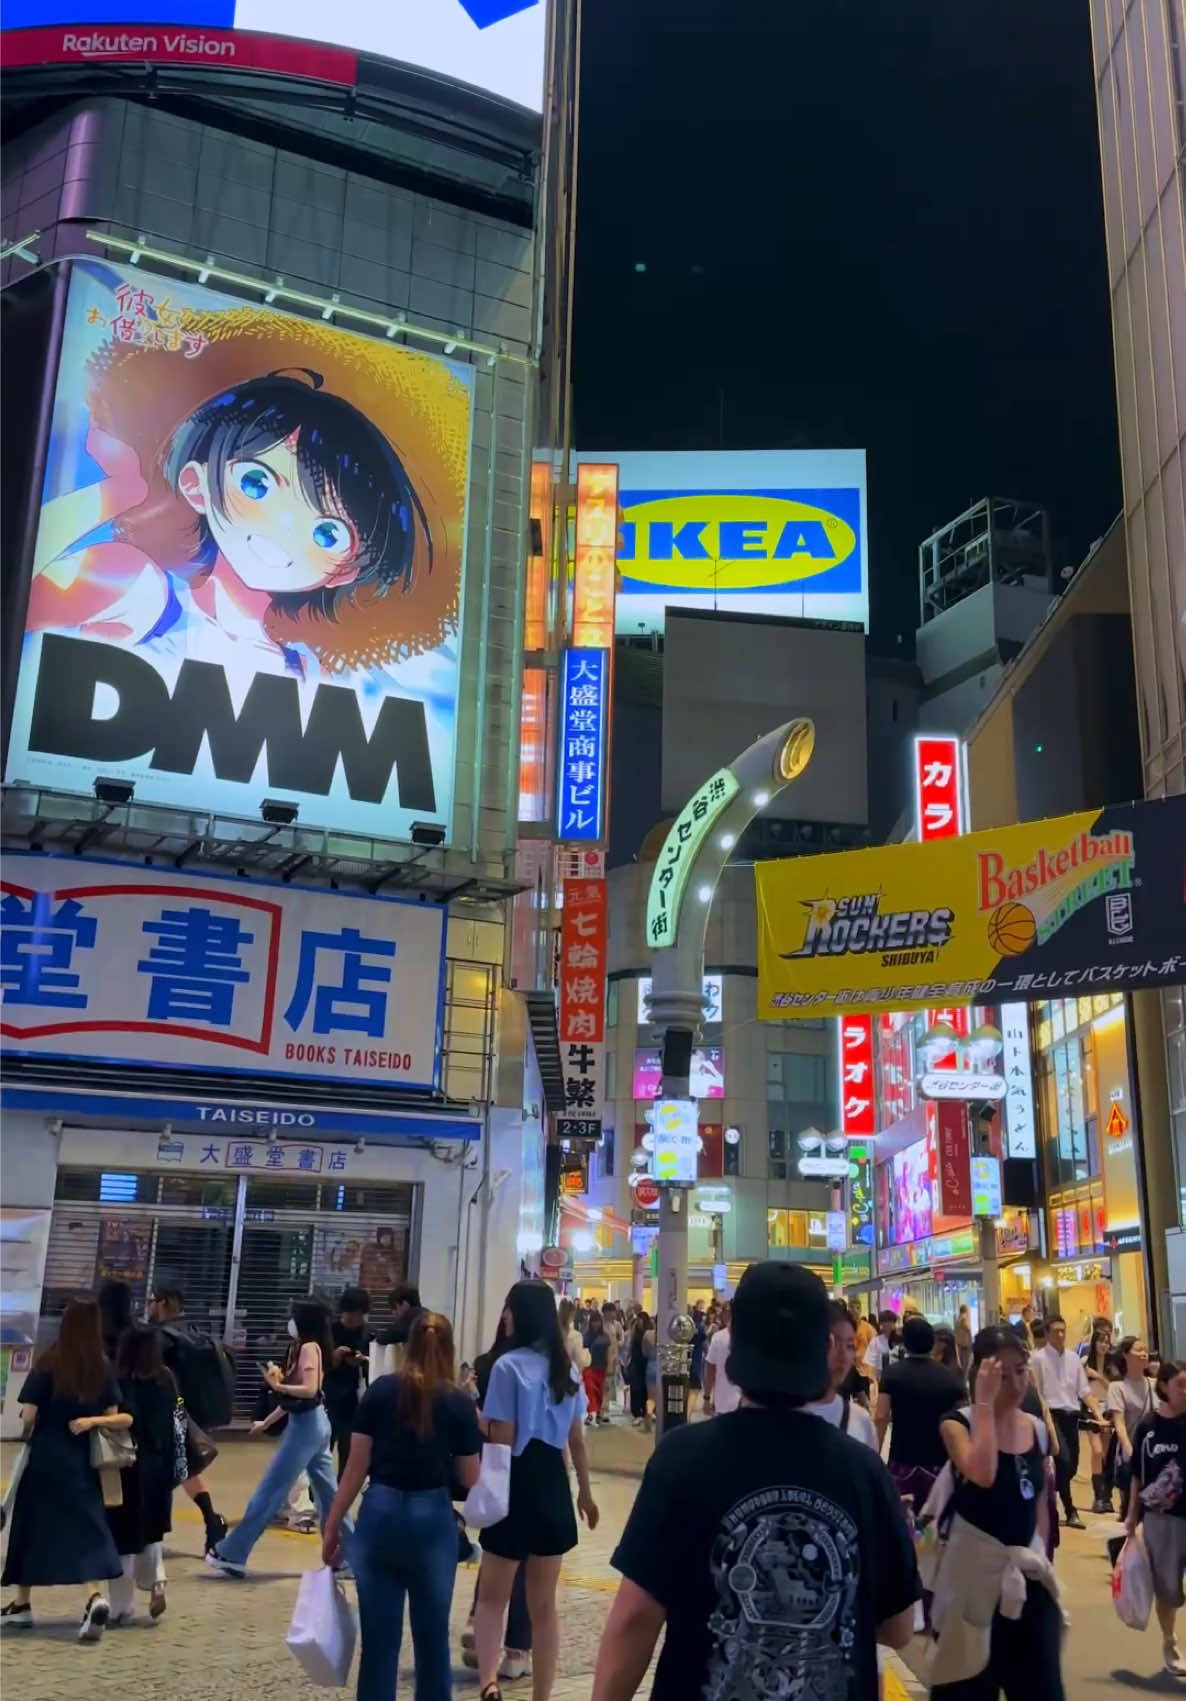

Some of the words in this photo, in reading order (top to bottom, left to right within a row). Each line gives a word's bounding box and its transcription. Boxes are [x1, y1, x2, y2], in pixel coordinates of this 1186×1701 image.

[62, 31, 158, 56] Rakuten
[163, 34, 236, 56] Vision
[617, 520, 836, 560] IKEA
[28, 632, 437, 813] DMM
[565, 657, 600, 832] 大盛堂商事ビル
[977, 831, 1131, 911] Basketball
[836, 894, 880, 917] SUN
[786, 898, 955, 958] ROCKERS
[565, 911, 601, 1037] 七輪焼肉
[880, 950, 935, 968] SHIBUYA
[285, 1043, 336, 1065] BOOKS
[343, 1048, 412, 1071] TAISEIDO
[197, 1106, 316, 1128] TAISEIDO
[200, 1143, 349, 1172] 大盛堂書店
